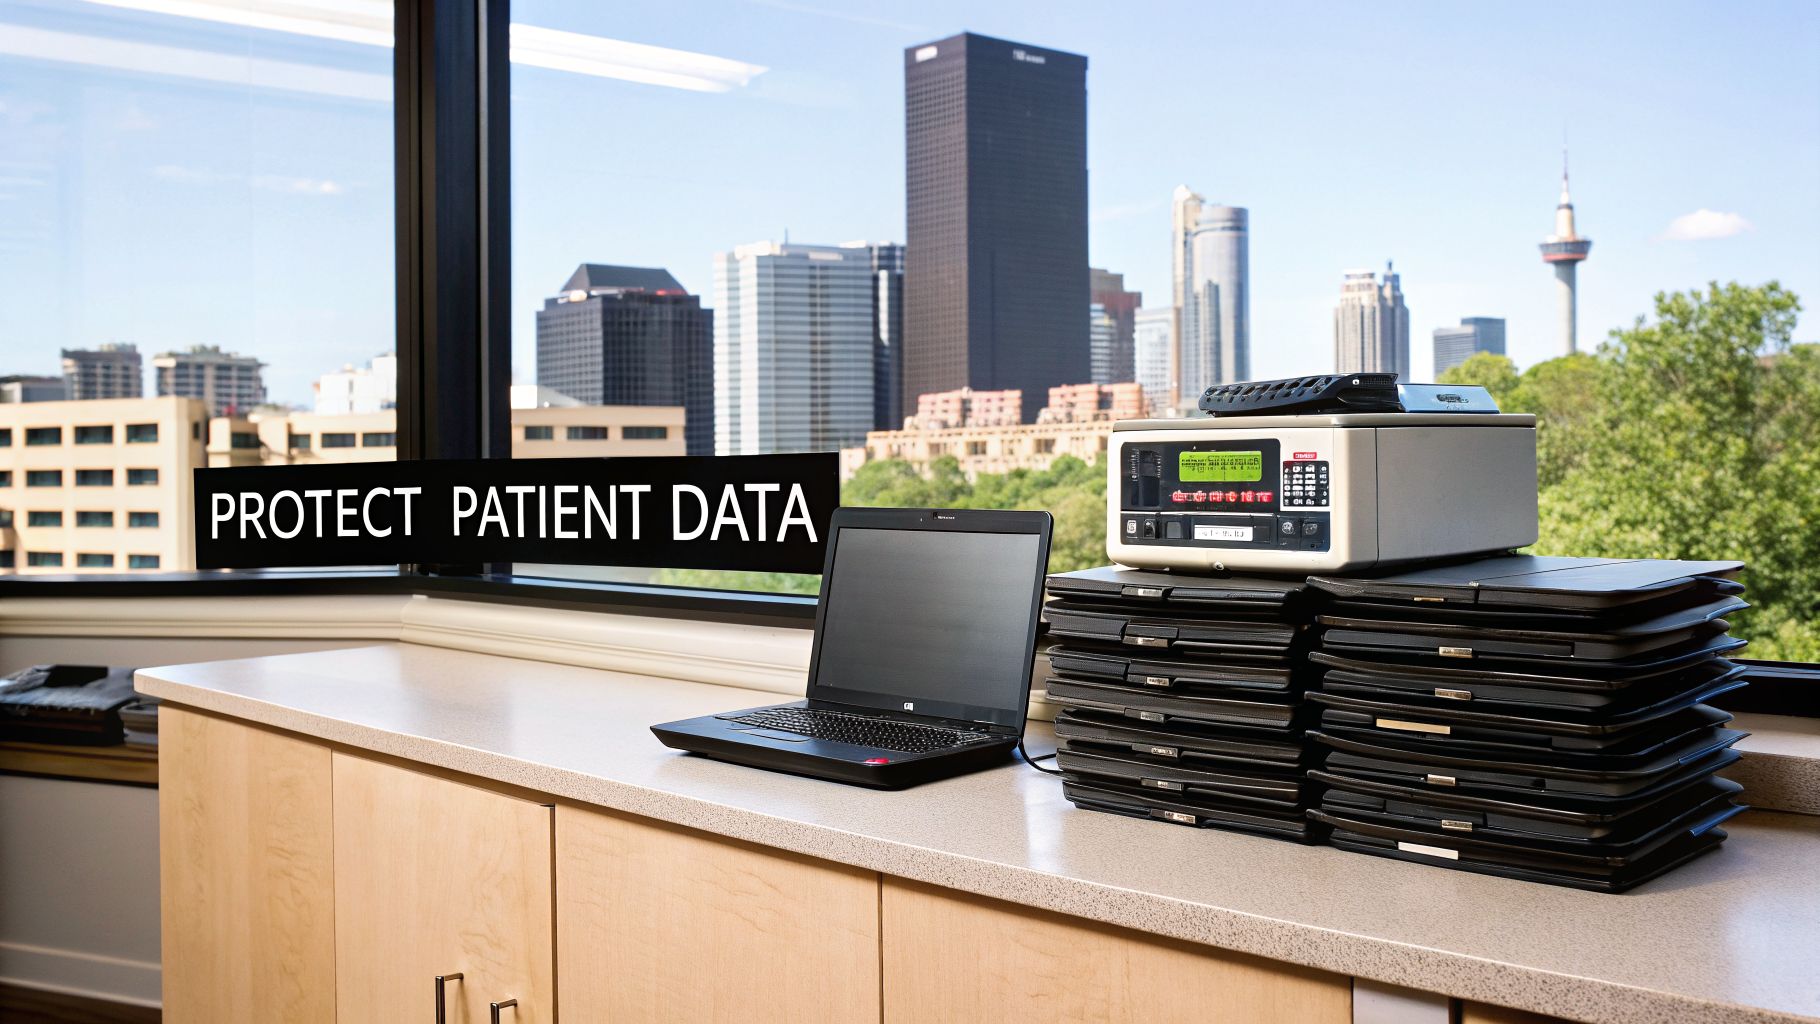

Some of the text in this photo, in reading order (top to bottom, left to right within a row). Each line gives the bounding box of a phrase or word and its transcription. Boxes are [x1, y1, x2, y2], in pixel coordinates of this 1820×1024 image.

[211, 482, 819, 543] PROTECT PATIENT DATA
